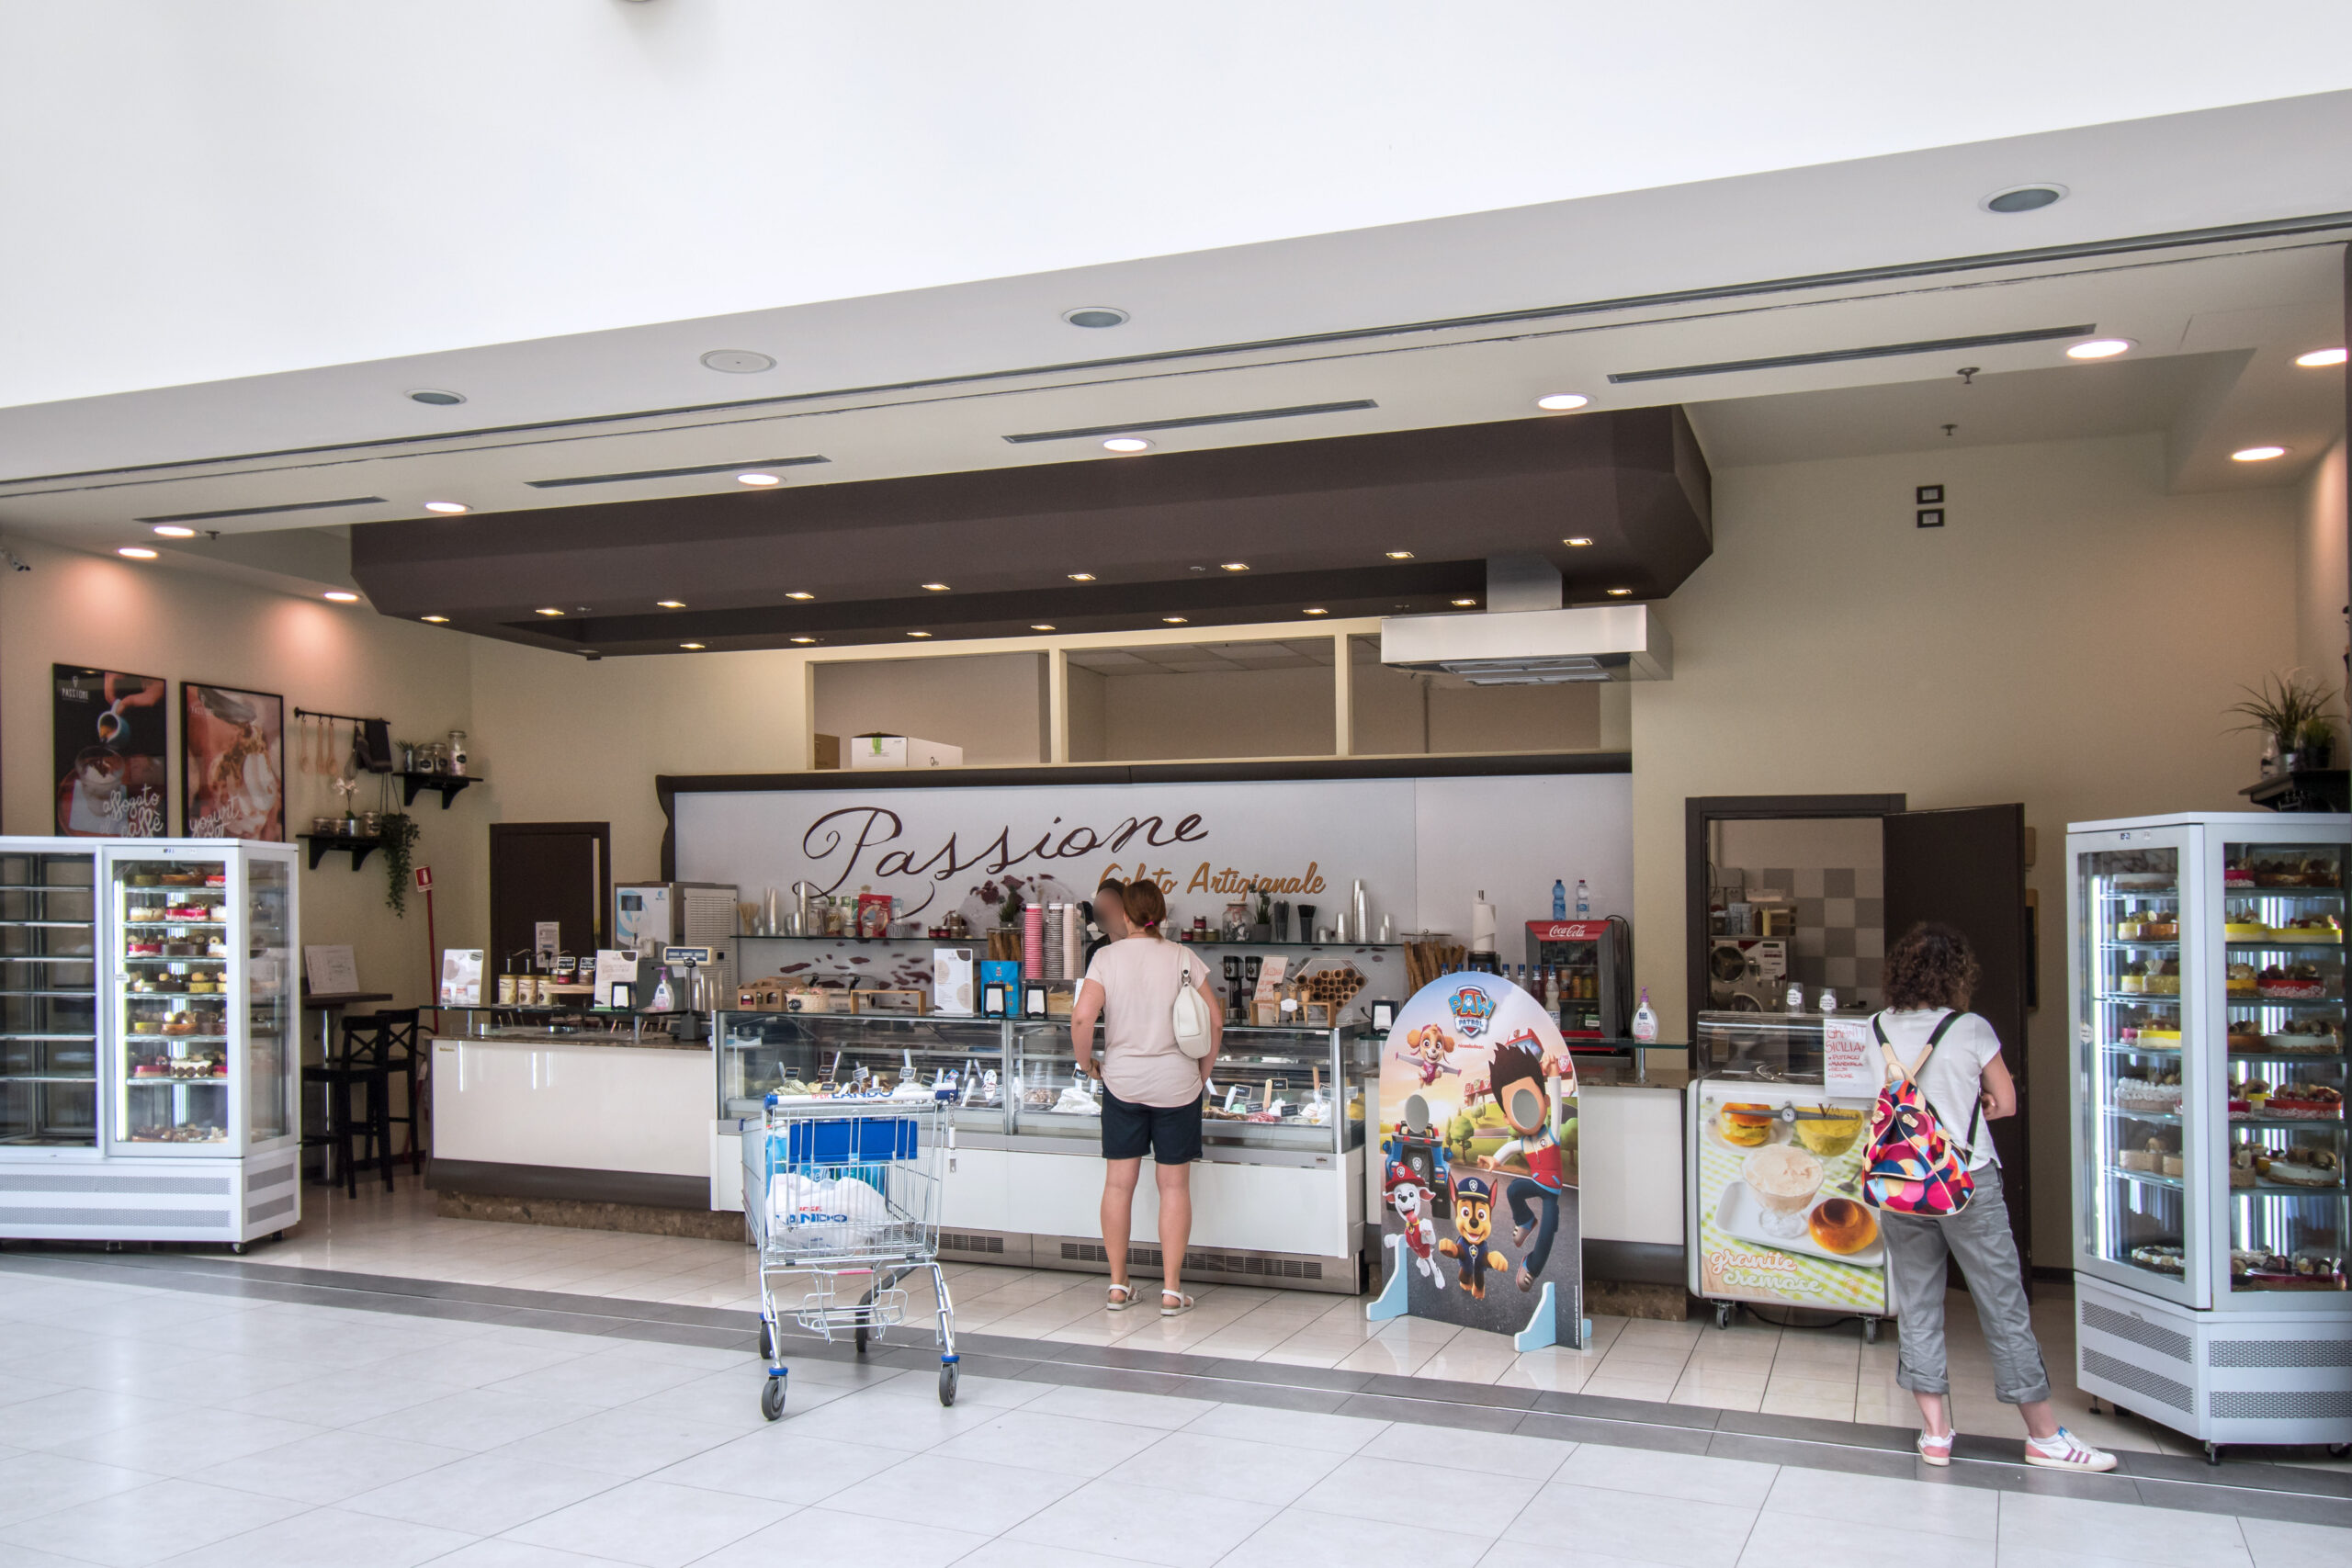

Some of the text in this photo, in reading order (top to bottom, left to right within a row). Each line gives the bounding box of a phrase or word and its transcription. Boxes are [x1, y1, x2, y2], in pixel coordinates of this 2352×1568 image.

[61, 687, 89, 700] PASSIONE
[102, 783, 161, 822] affogato
[189, 795, 239, 838] yogurt
[792, 807, 1209, 919] Passione
[1099, 861, 1326, 901] Gelto Artigianale
[1448, 993, 1497, 1019] PAW
[1458, 1019, 1484, 1027] PATROL
[1710, 1248, 1798, 1275] granite
[1722, 1269, 1824, 1293] cremose
